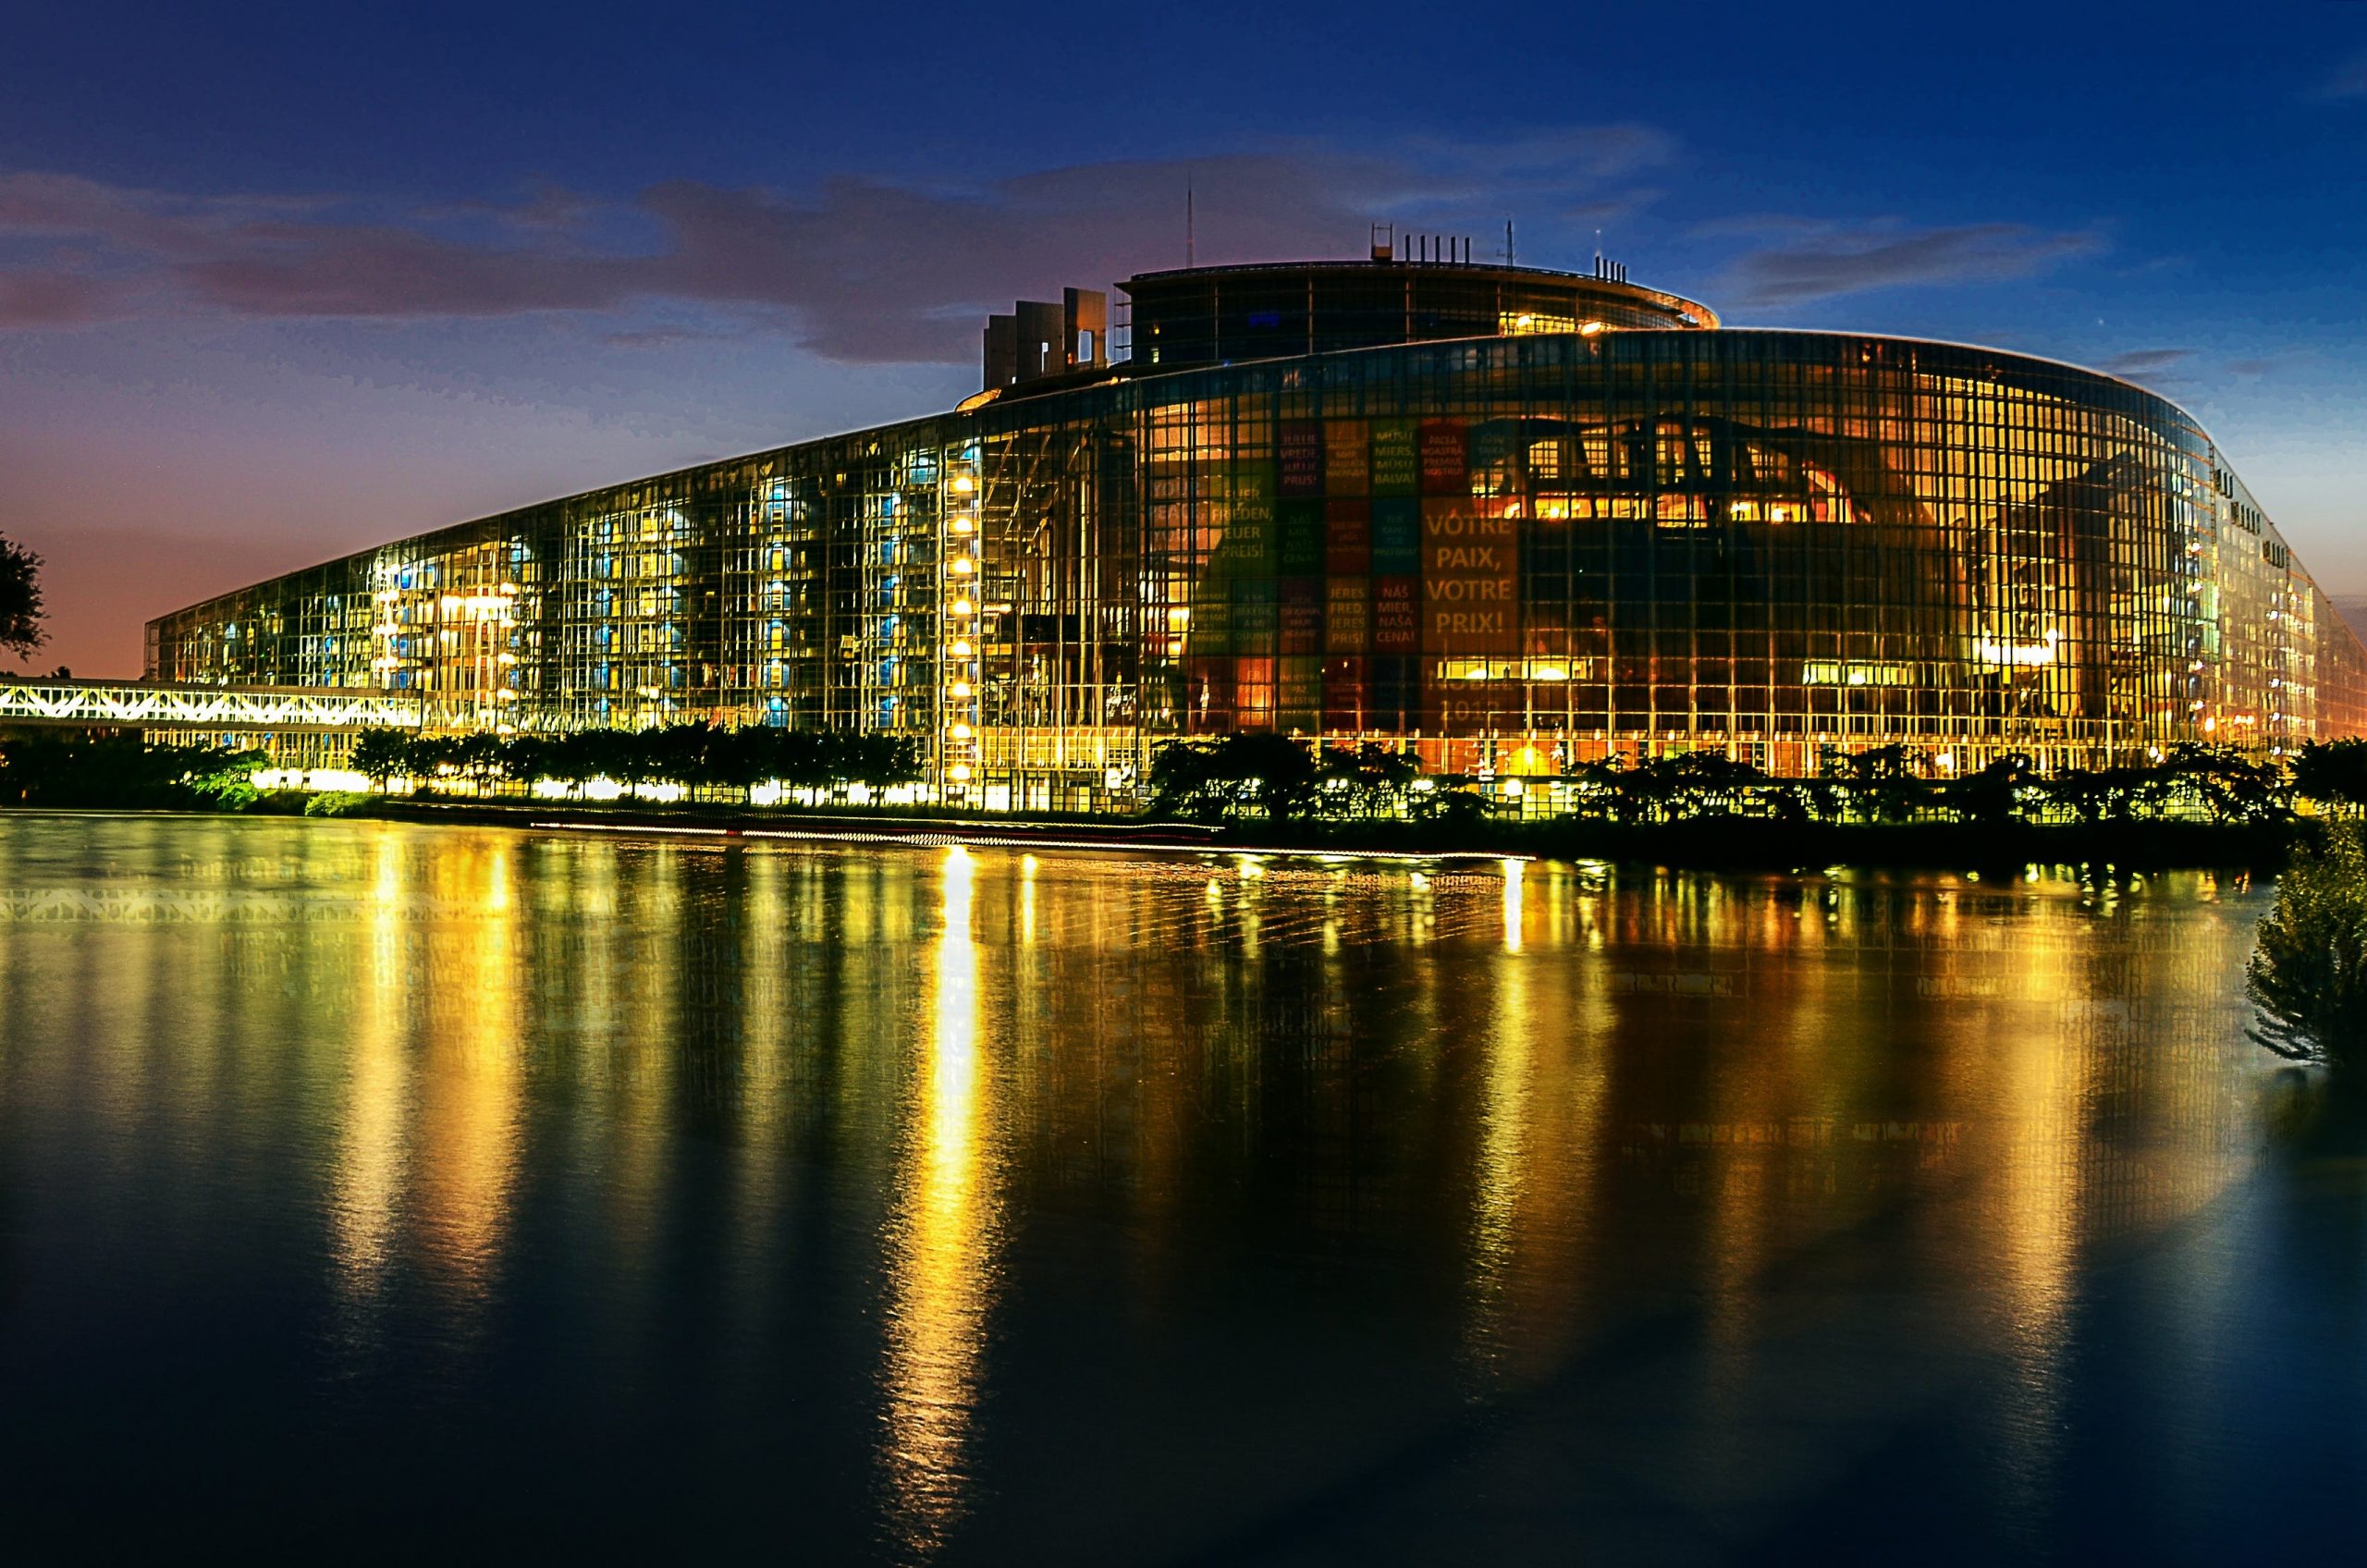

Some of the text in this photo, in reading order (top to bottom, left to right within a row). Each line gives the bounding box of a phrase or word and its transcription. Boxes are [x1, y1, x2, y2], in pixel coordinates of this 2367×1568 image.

[1375, 447, 1415, 457] MIERS,
[1375, 473, 1416, 484] BALVA!
[1225, 527, 1261, 539] EUER
[1221, 544, 1264, 558] PREIS!
[1437, 547, 1502, 571] PAIX,
[1331, 586, 1365, 599] JERES
[1427, 579, 1512, 601] VOTRE
[1331, 603, 1366, 614] FRED,
[1378, 601, 1414, 614] MIER,
[1379, 614, 1414, 628] NAŠA
[1437, 611, 1502, 633] PRIX!
[1332, 632, 1365, 644] PRIS!
[1377, 631, 1415, 643] CENA!
